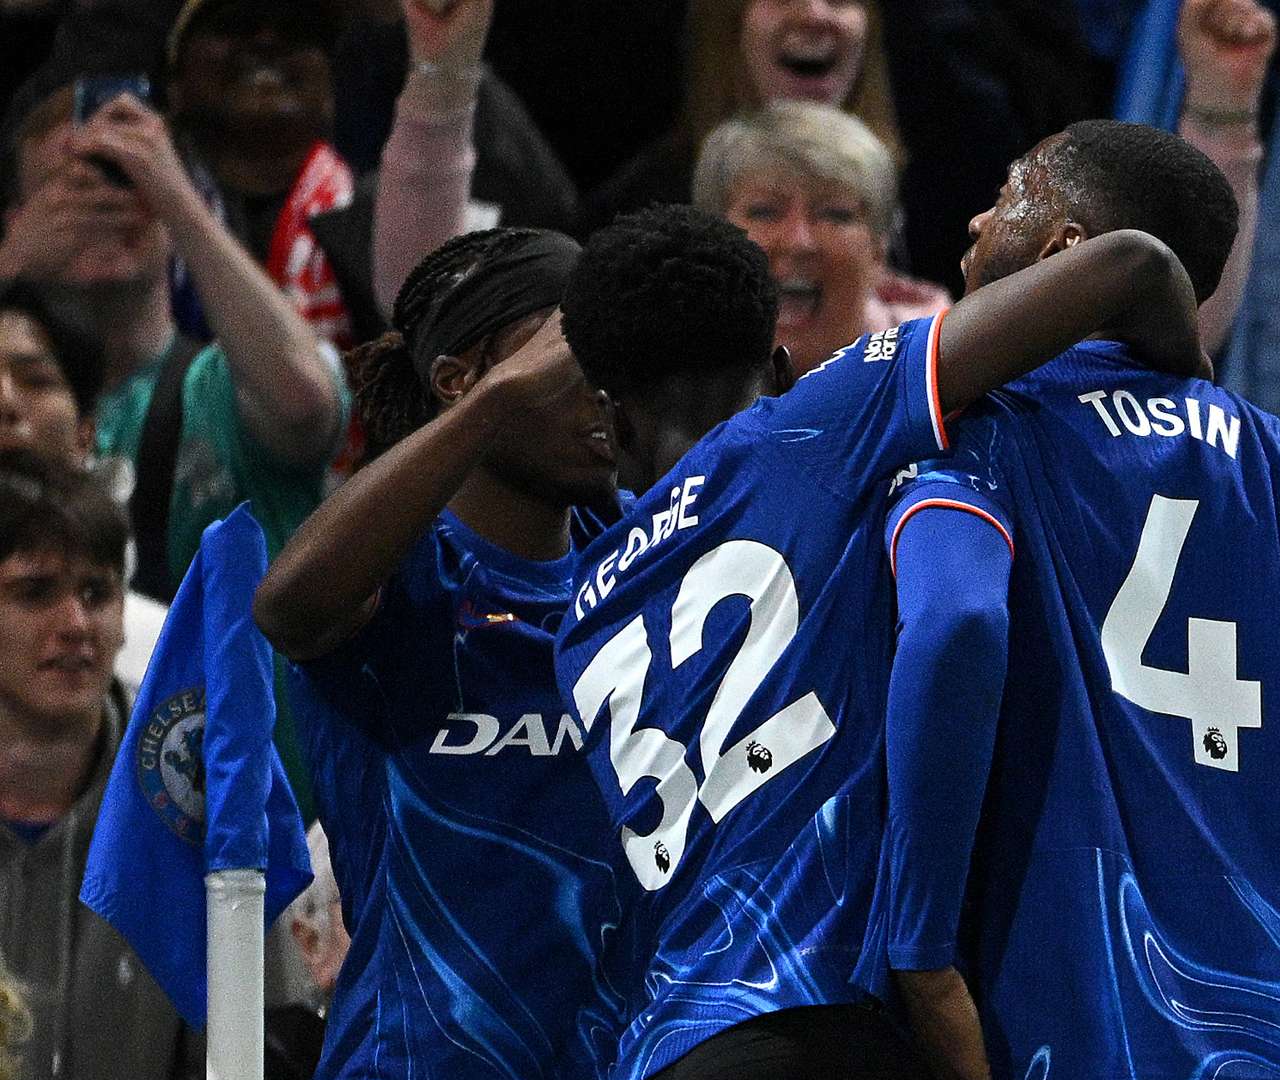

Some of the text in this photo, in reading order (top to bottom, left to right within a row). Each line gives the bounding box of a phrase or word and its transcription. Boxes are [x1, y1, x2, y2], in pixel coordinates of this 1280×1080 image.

[1078, 389, 1241, 460] TOSIN
[572, 539, 837, 892] 32
[1101, 493, 1262, 772] 4
